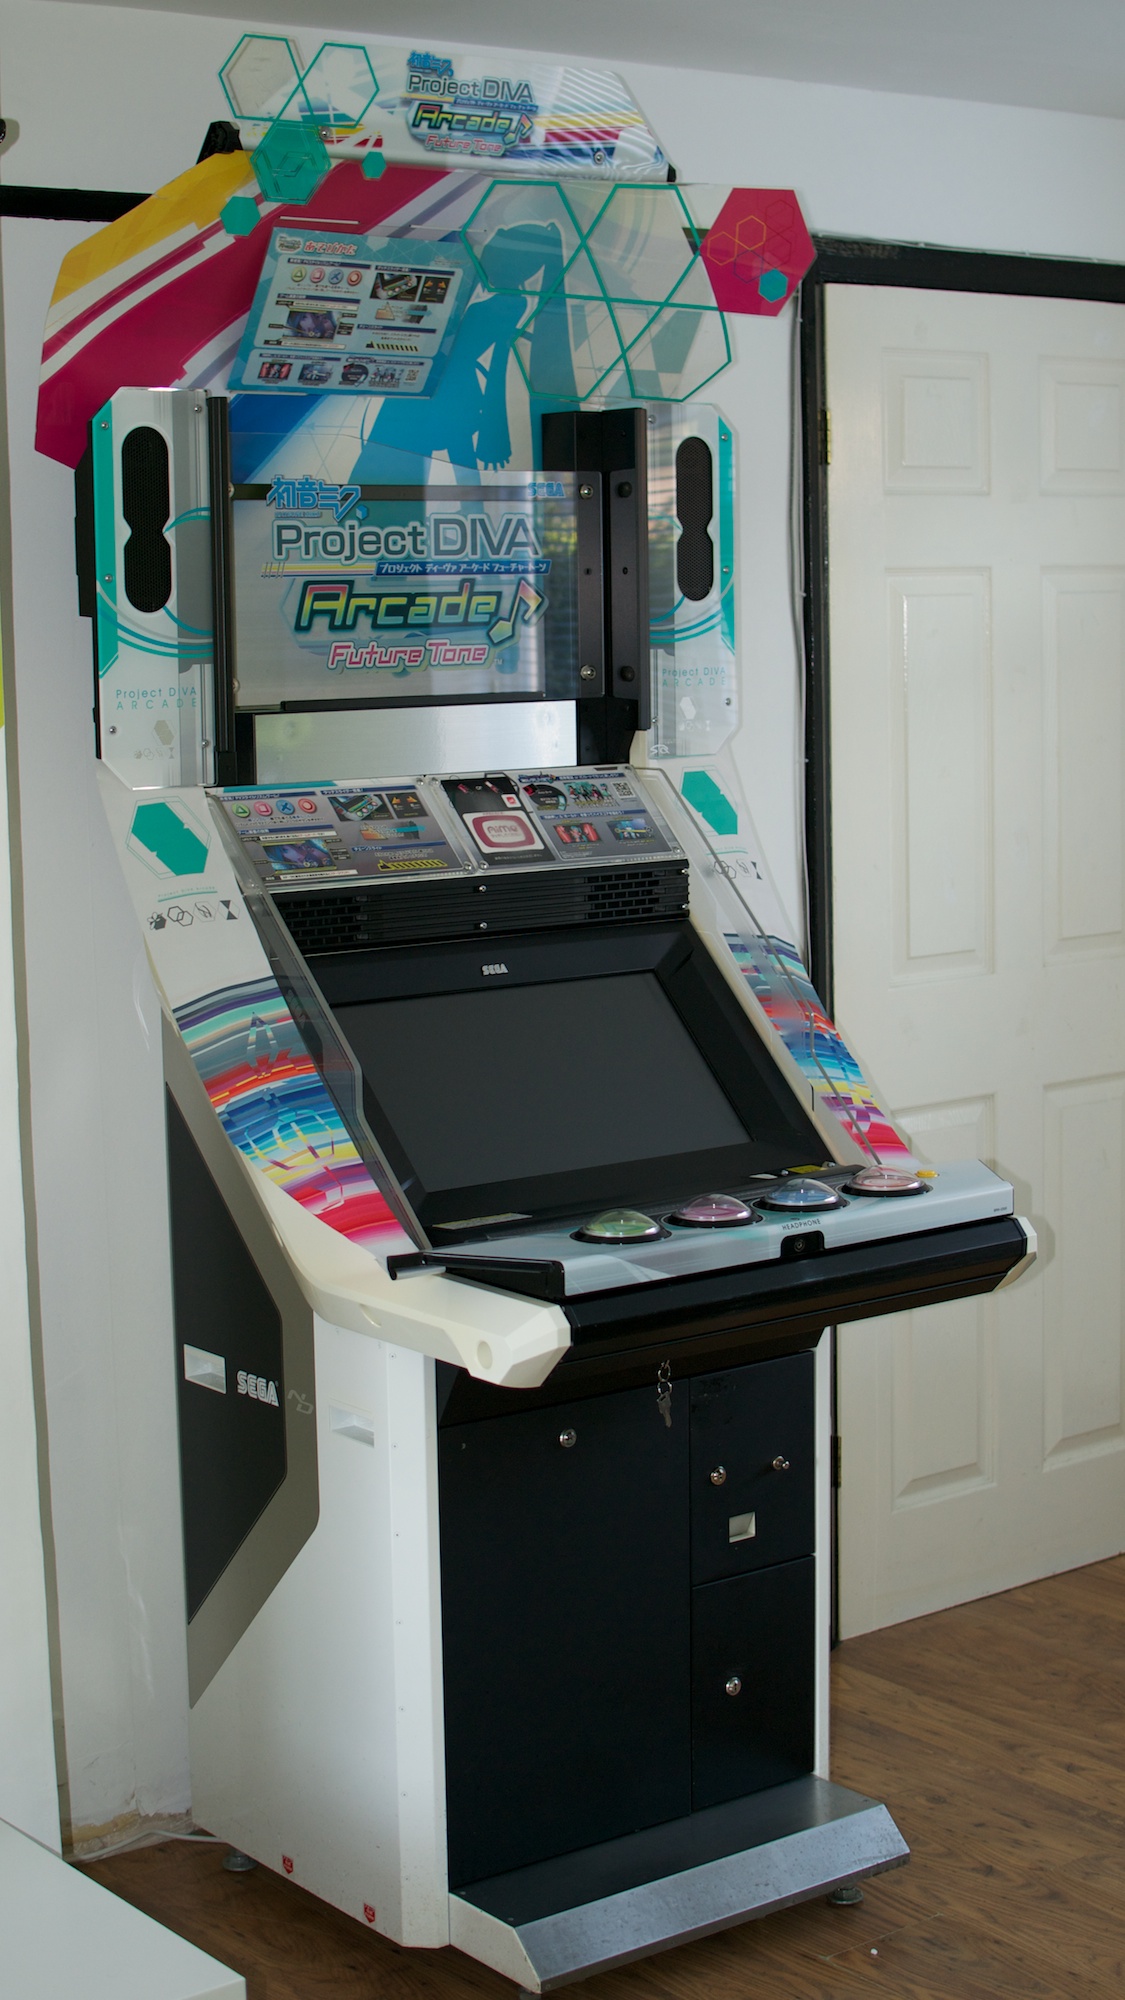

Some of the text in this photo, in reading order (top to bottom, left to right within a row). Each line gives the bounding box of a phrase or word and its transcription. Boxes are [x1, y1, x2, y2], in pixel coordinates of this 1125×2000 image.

[408, 75, 534, 102] Project DIVA
[412, 102, 513, 134] Arcade
[425, 135, 503, 153] Future Tone
[527, 481, 566, 498] SEGA
[266, 475, 362, 522] 初音ミク
[275, 517, 539, 561] Project DIVA
[379, 562, 423, 574] プロジェクト
[459, 562, 490, 573] アーケード
[295, 578, 502, 631] Arcade
[329, 643, 424, 667] Future
[427, 641, 488, 664] Tone
[662, 667, 726, 678] Project DIVA
[662, 677, 726, 687] ARCADE
[116, 686, 197, 700] Project DIVA
[116, 698, 197, 710] ARCADE
[481, 963, 509, 976] SEGA
[781, 1218, 821, 1231] HEADPHONE
[236, 1369, 279, 1408] SEGA
